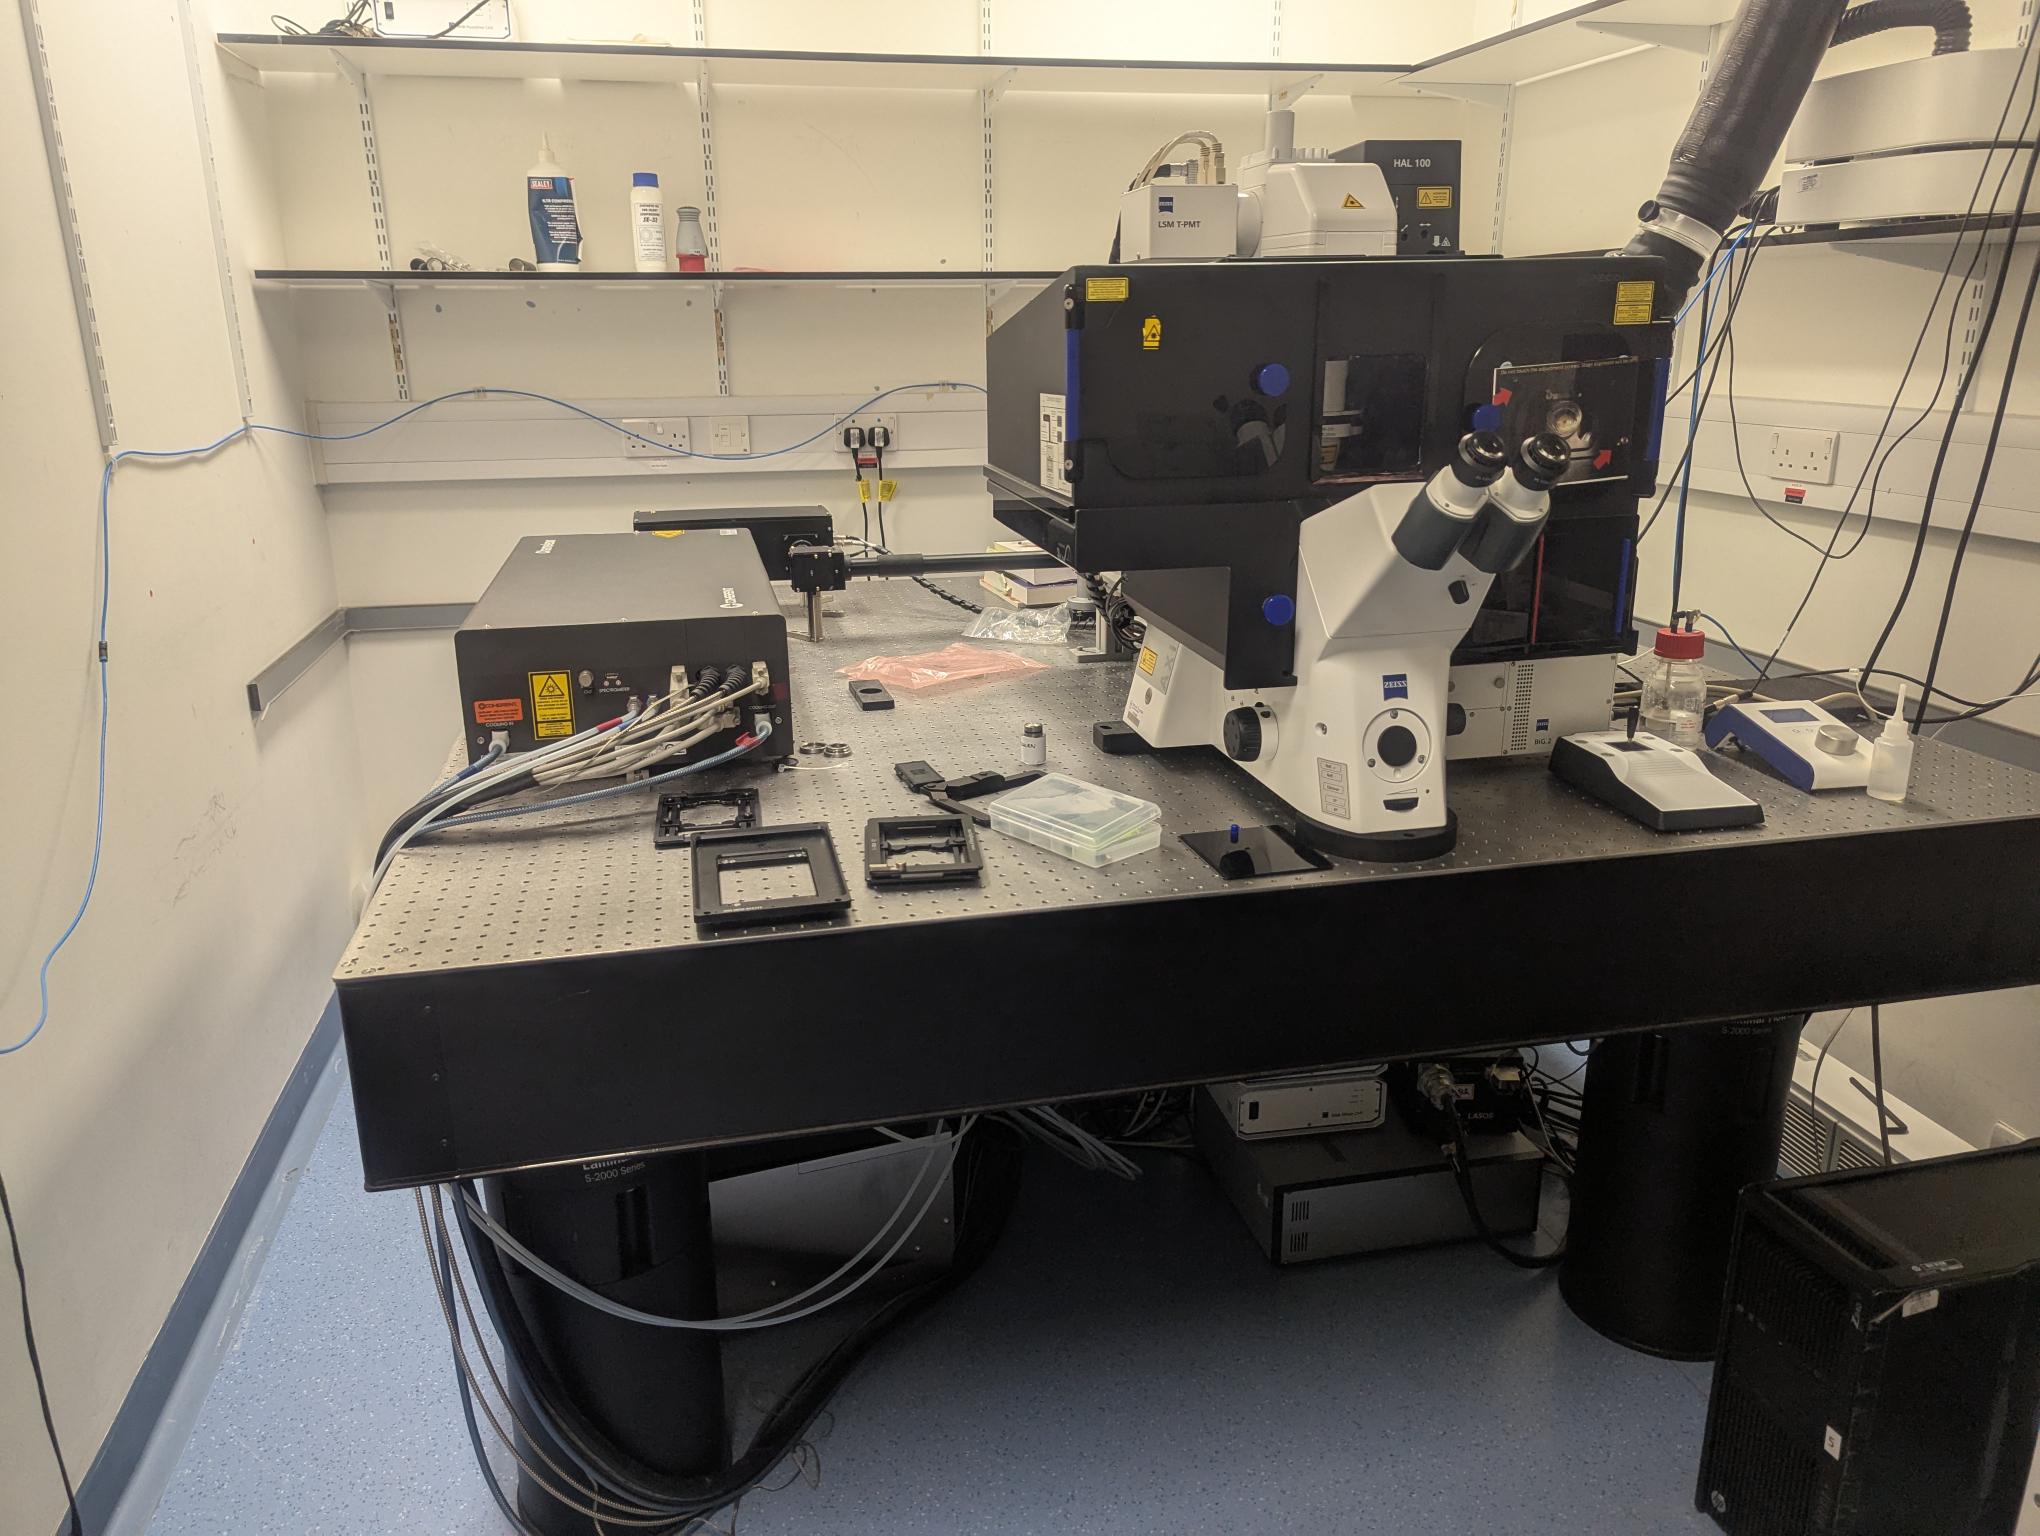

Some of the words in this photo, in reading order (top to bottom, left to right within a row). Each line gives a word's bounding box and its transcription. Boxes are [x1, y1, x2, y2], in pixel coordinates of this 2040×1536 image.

[1393, 159, 1413, 168] HAL
[1414, 159, 1432, 168] 100
[1158, 220, 1175, 228] LSM
[1176, 220, 1202, 228] T-PMT
[1383, 680, 1408, 689] ZEISS
[584, 1167, 619, 1183] S-2000
[619, 1161, 646, 1175] Series
